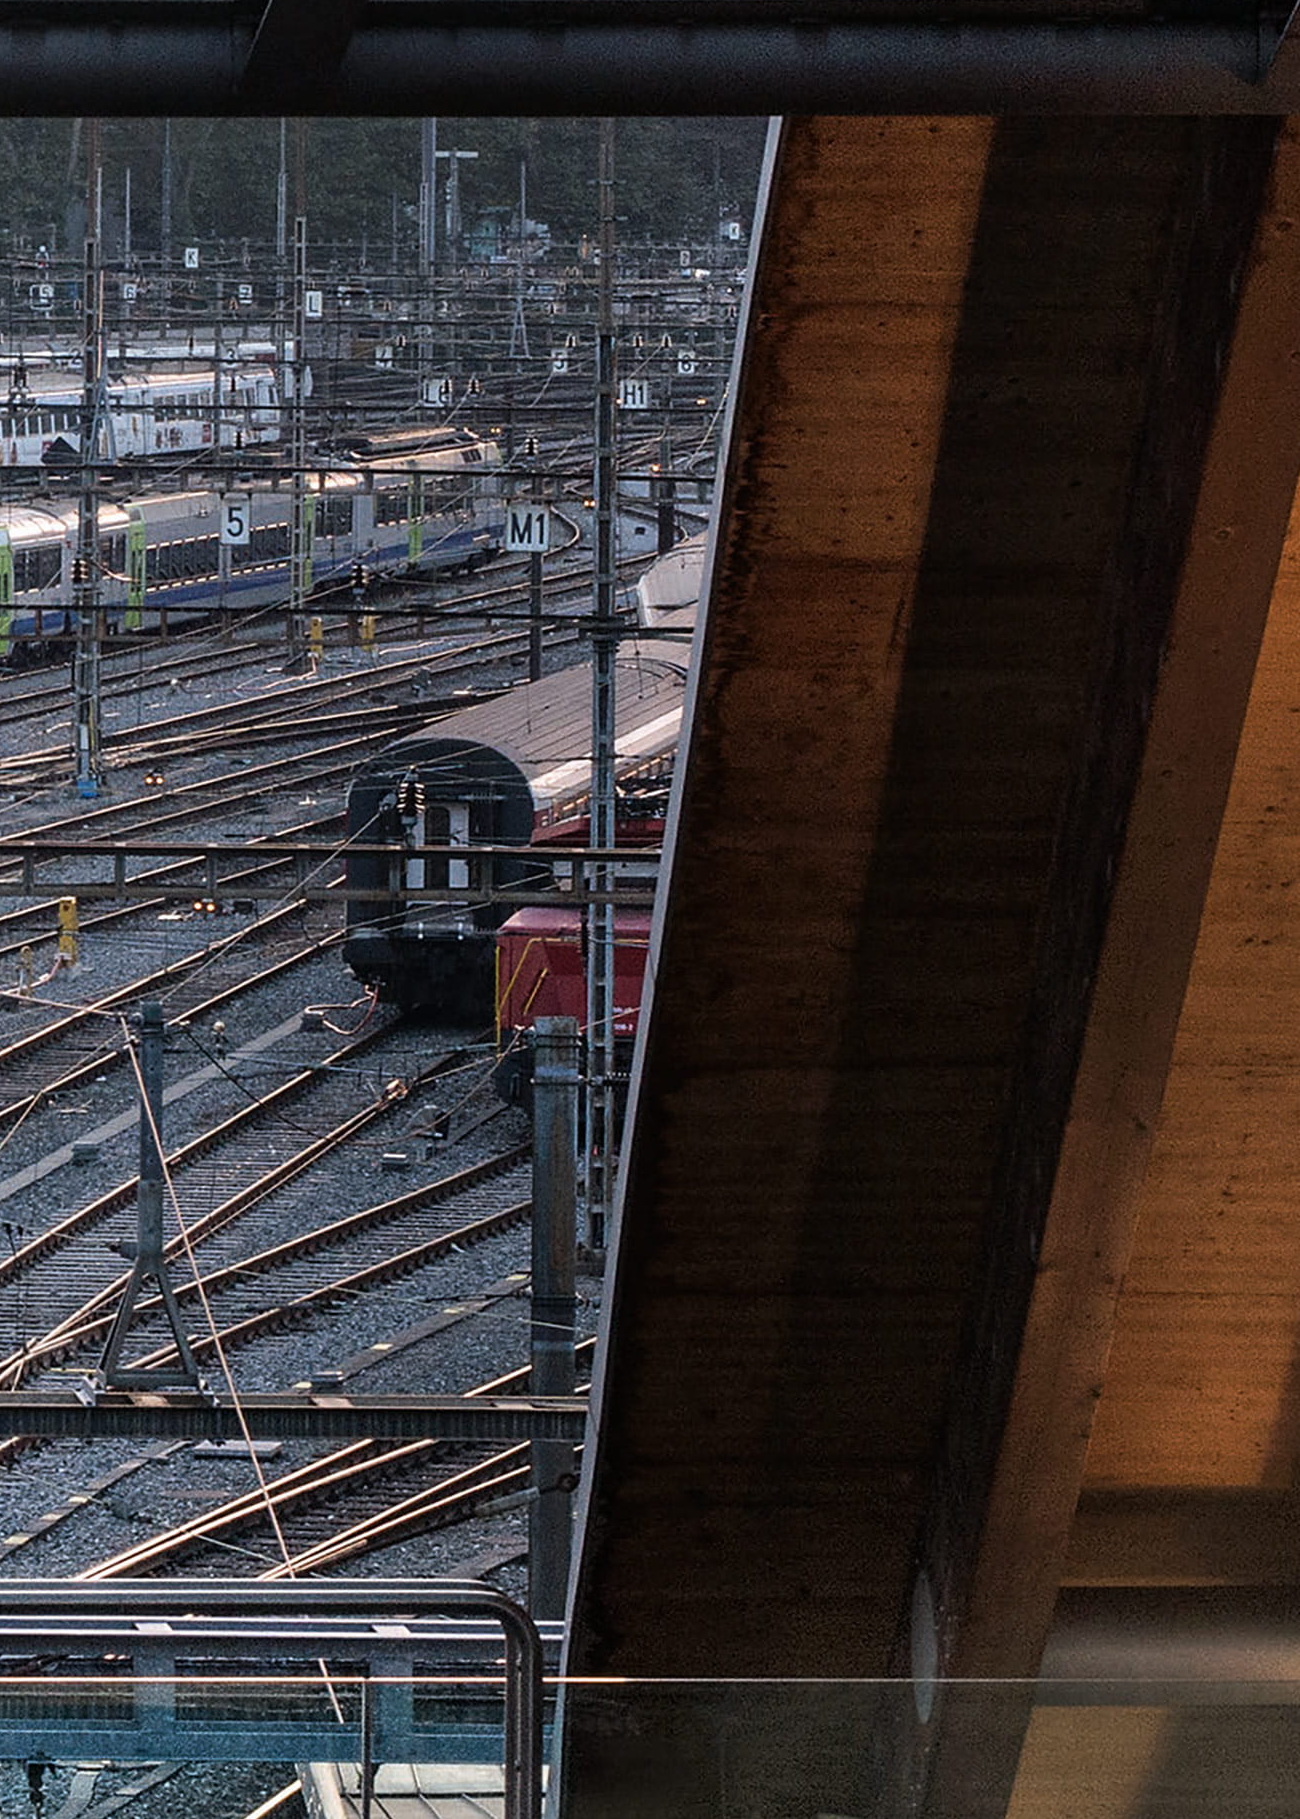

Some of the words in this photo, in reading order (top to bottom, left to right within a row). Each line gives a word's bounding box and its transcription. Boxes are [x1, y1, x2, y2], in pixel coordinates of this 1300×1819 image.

[623, 384, 647, 405] H1
[226, 507, 244, 537] 5
[511, 512, 545, 544] M1
